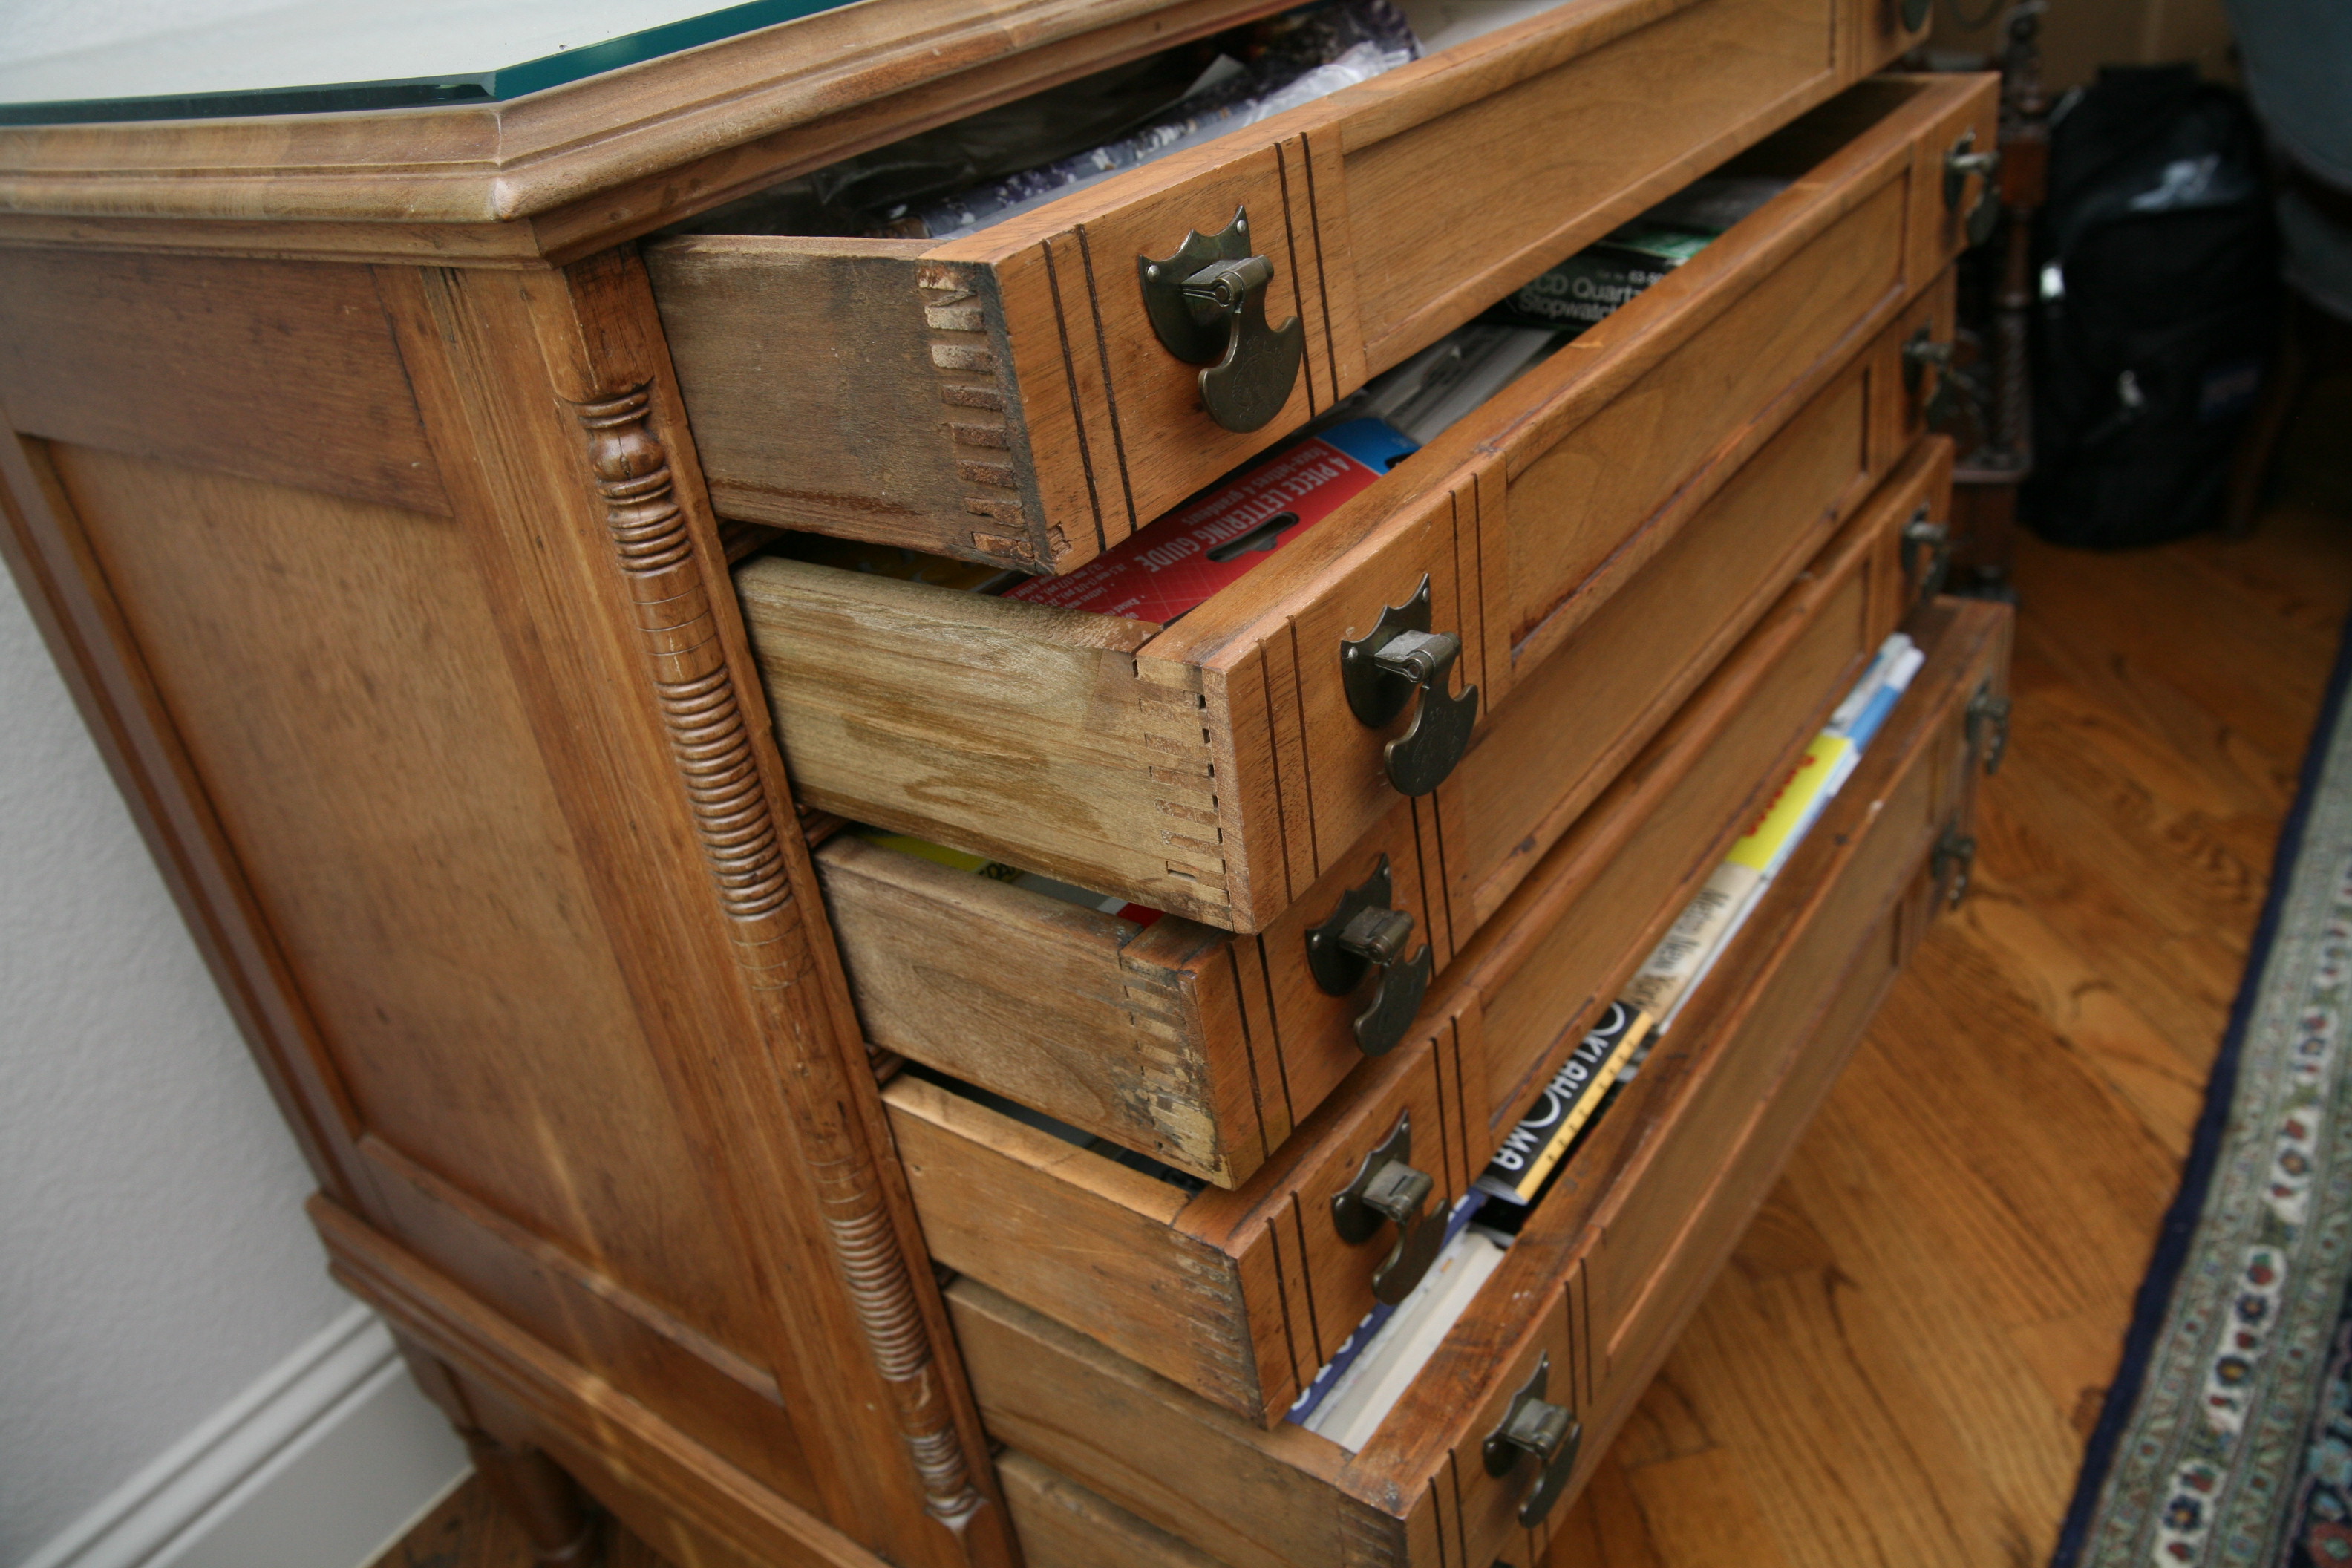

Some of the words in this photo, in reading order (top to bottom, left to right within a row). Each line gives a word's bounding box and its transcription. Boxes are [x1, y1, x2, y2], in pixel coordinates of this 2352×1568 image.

[1290, 462, 1340, 496] PIECE
[1329, 457, 1350, 471] 4
[1198, 489, 1294, 545] LETTERING
[1134, 537, 1200, 573] GUIDE
